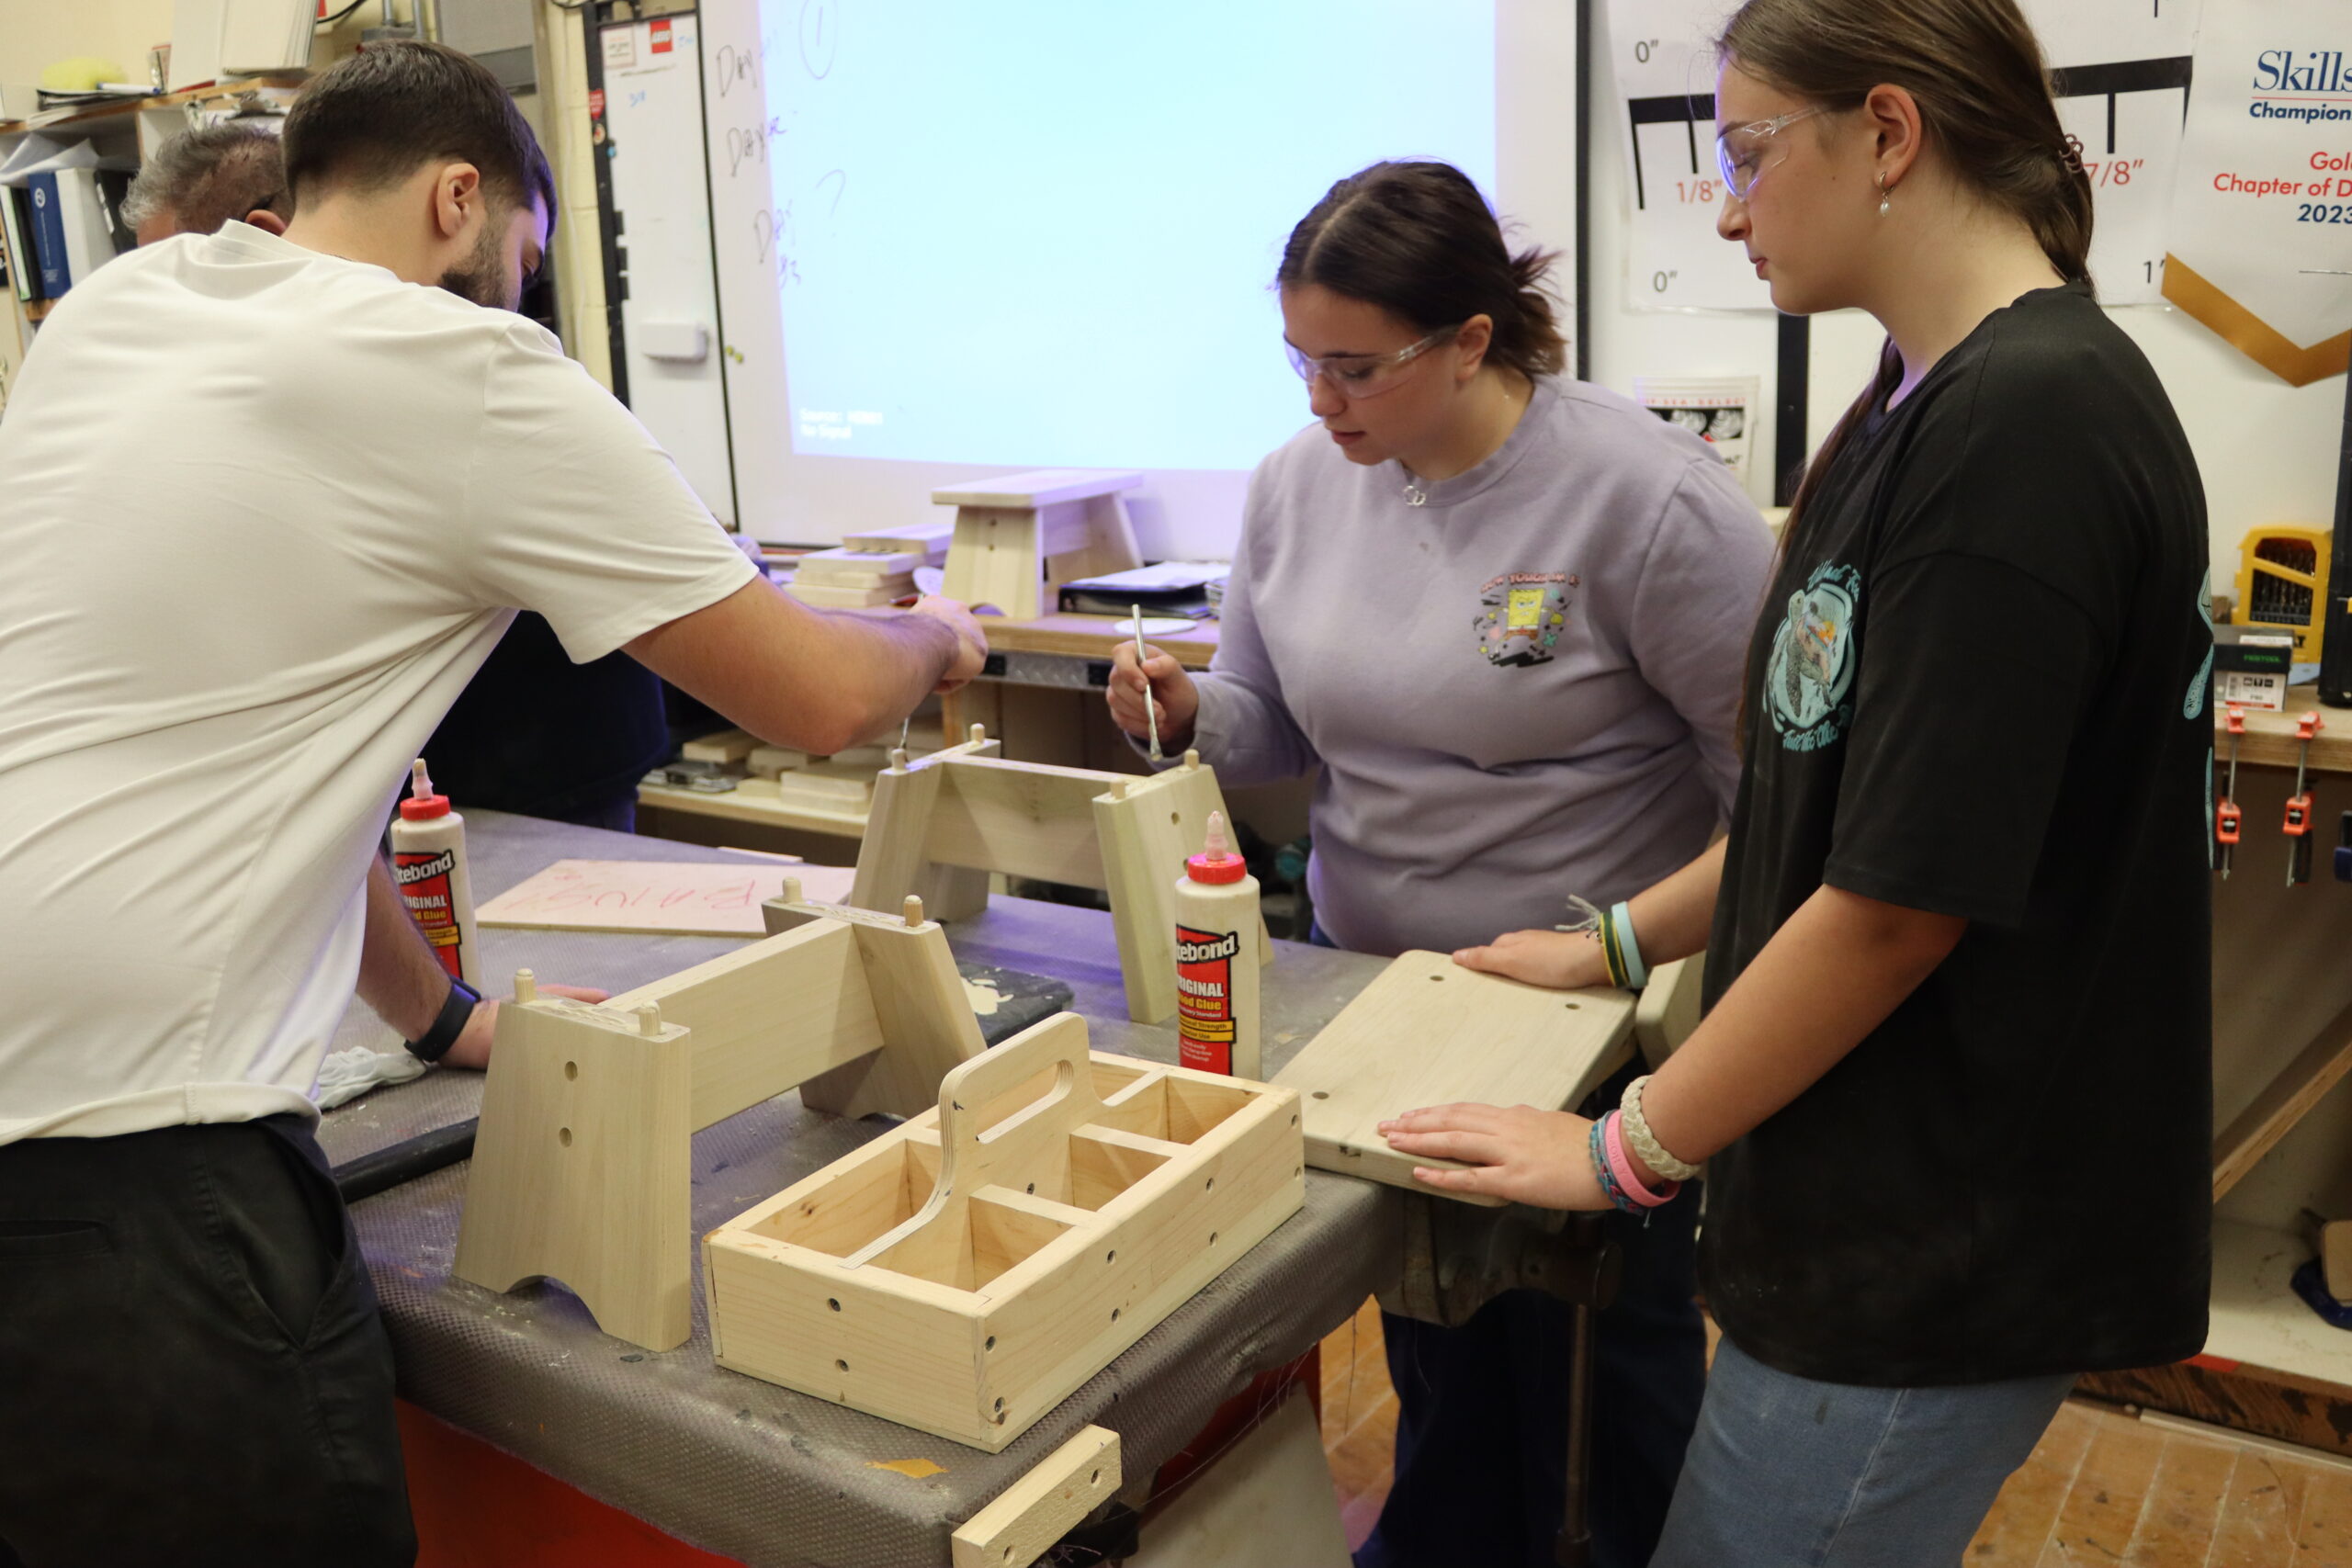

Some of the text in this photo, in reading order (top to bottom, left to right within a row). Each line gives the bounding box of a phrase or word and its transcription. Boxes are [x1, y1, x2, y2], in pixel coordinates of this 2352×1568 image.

[2309, 151, 2352, 172] Gol
[2213, 173, 2304, 198] Chapter
[2307, 177, 2334, 197] of
[1195, 998, 1222, 1011] Glue
